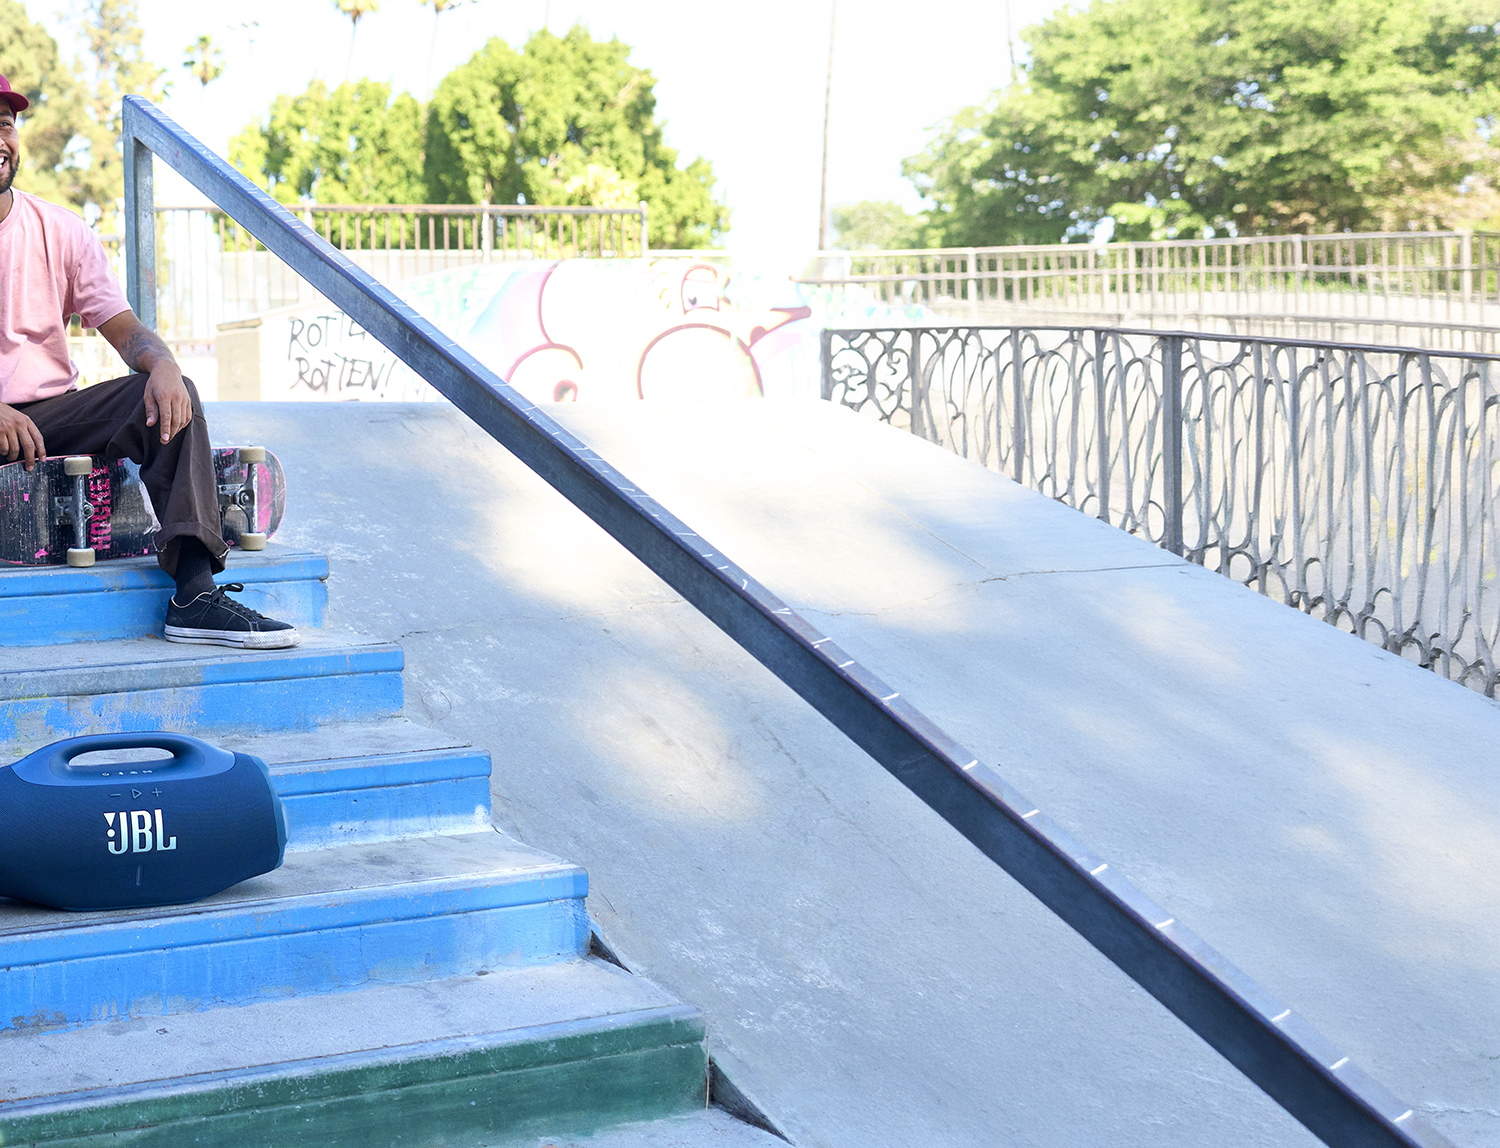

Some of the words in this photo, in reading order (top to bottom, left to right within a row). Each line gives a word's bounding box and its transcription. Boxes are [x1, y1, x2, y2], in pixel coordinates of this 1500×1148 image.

[290, 352, 398, 398] ROTTEN!
[89, 466, 111, 551] HOCKEY
[104, 808, 177, 855] JBL
